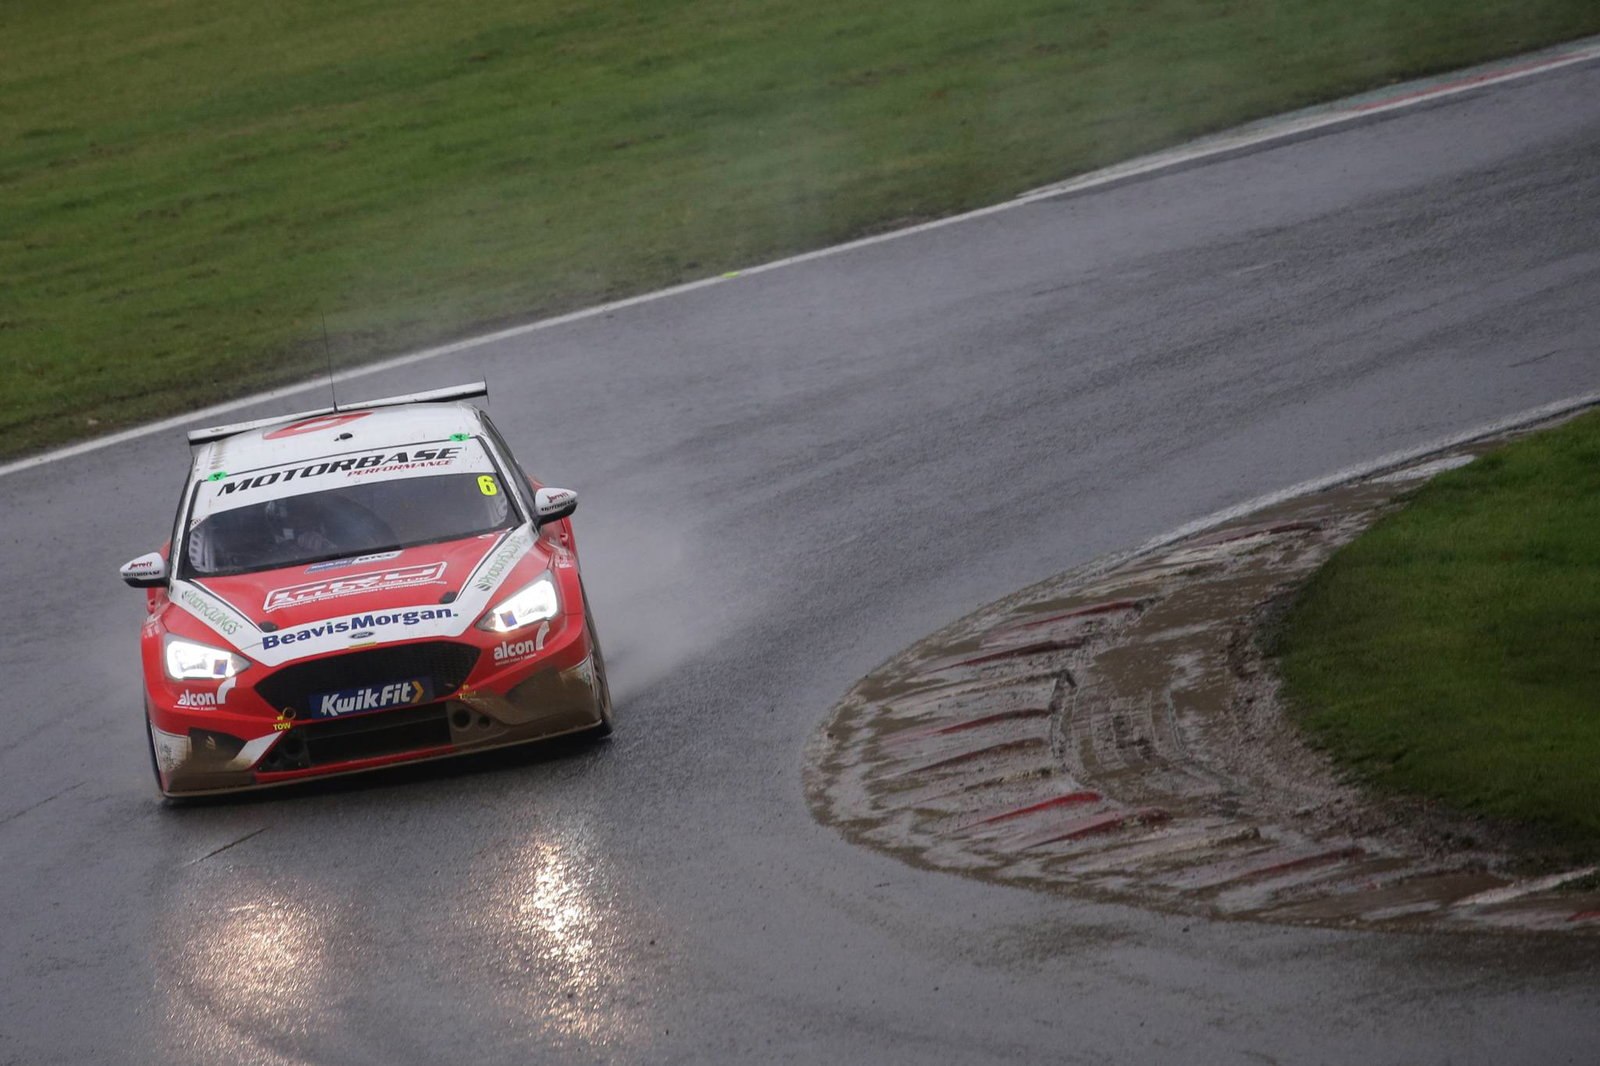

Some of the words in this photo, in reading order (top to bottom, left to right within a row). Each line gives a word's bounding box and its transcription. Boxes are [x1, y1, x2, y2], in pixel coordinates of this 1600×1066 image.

[217, 446, 463, 496] MOTORBASE
[346, 459, 455, 478] PERFORMANCE
[476, 475, 498, 497] 6
[493, 640, 535, 660] alcon
[177, 688, 216, 707] alcon
[272, 722, 292, 731] TOW
